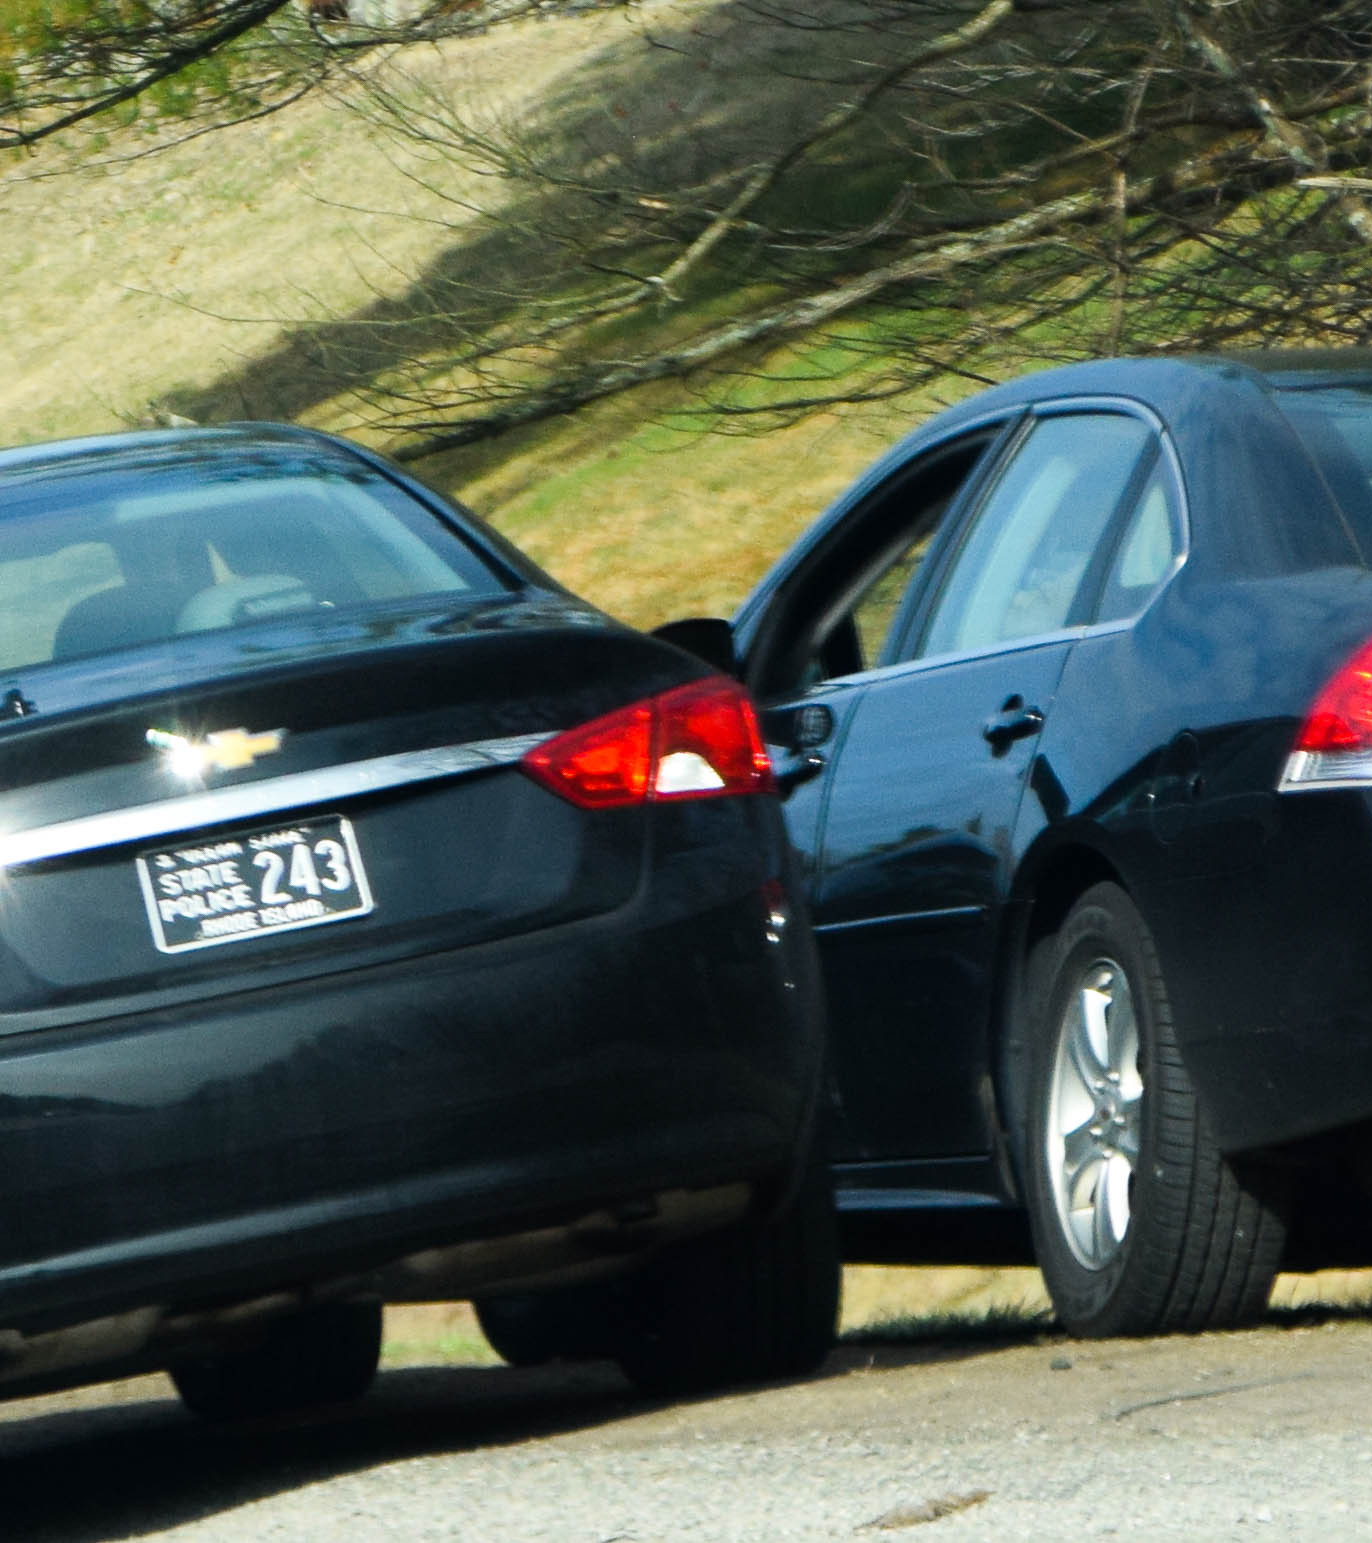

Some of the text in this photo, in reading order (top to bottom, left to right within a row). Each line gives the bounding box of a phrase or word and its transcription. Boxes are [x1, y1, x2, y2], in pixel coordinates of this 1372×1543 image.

[158, 861, 244, 896] STATE
[252, 839, 351, 905] 243
[158, 884, 256, 923] POLICE
